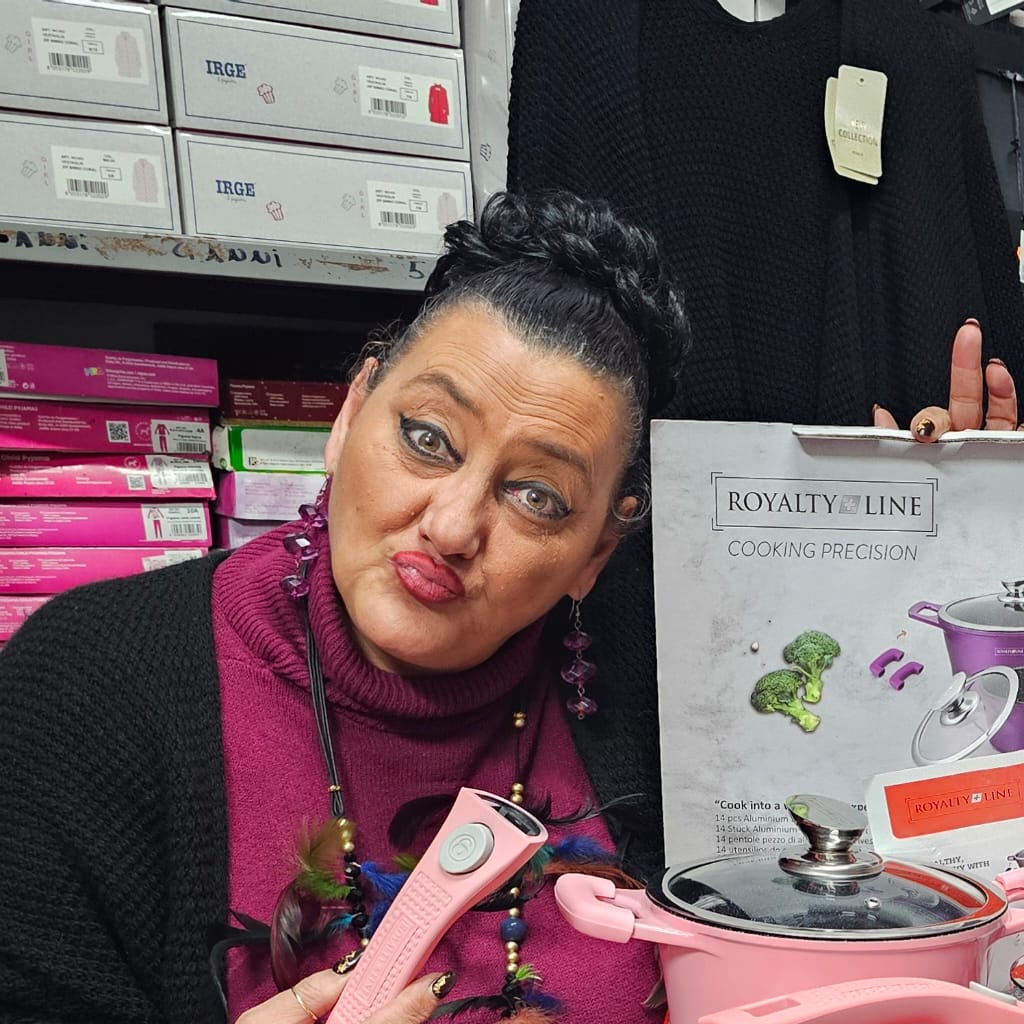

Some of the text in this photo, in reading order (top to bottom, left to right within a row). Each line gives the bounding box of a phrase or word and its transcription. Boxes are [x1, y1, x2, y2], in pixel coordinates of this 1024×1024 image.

[206, 60, 246, 79] IRGE
[838, 128, 879, 147] COLLECTION
[216, 180, 256, 197] IRGE
[728, 491, 923, 517] ROYALTY LINE
[728, 540, 919, 561] COOKING PRECISION
[750, 800, 772, 810] into
[774, 802, 781, 810] a
[913, 787, 1015, 815] ROYALTY LINE
[728, 815, 742, 823] pcs
[744, 814, 789, 823] Aluminium
[715, 824, 798, 834] 14 Aluminium
[716, 835, 726, 843] 14
[728, 835, 760, 844] pentole
[787, 836, 796, 844] di
[969, 860, 991, 871] WITH
